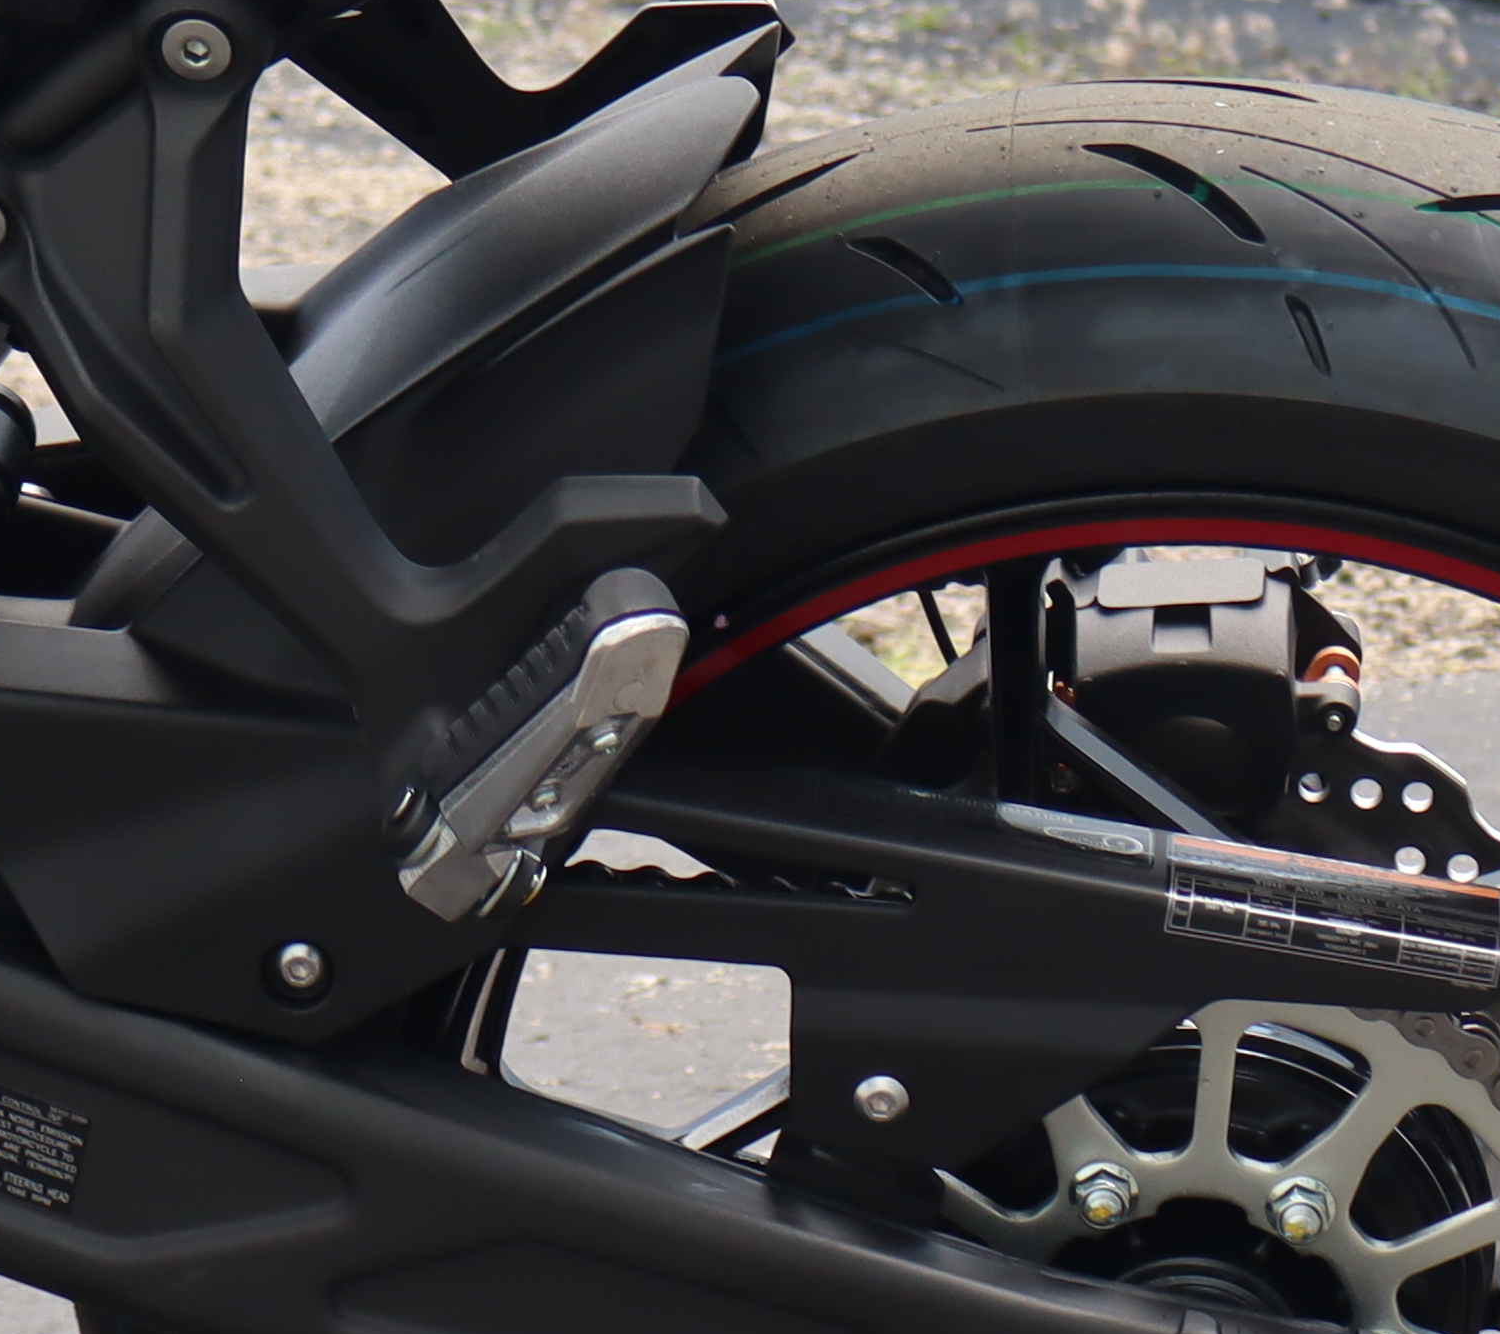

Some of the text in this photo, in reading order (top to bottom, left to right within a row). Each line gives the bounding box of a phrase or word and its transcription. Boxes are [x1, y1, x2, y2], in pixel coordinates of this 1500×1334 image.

[1294, 885, 1325, 897] AND
[1337, 892, 1377, 906] LOAD
[1384, 901, 1422, 914] DATA
[1, 1095, 40, 1115] CONTROL
[8, 1112, 35, 1128] NOISE
[40, 1124, 83, 1145] EMISSION
[3, 1141, 19, 1153] ARE
[24, 1149, 76, 1174] PROHIBITED
[3, 1171, 43, 1194] STEERING
[46, 1187, 69, 1203] HEAD
